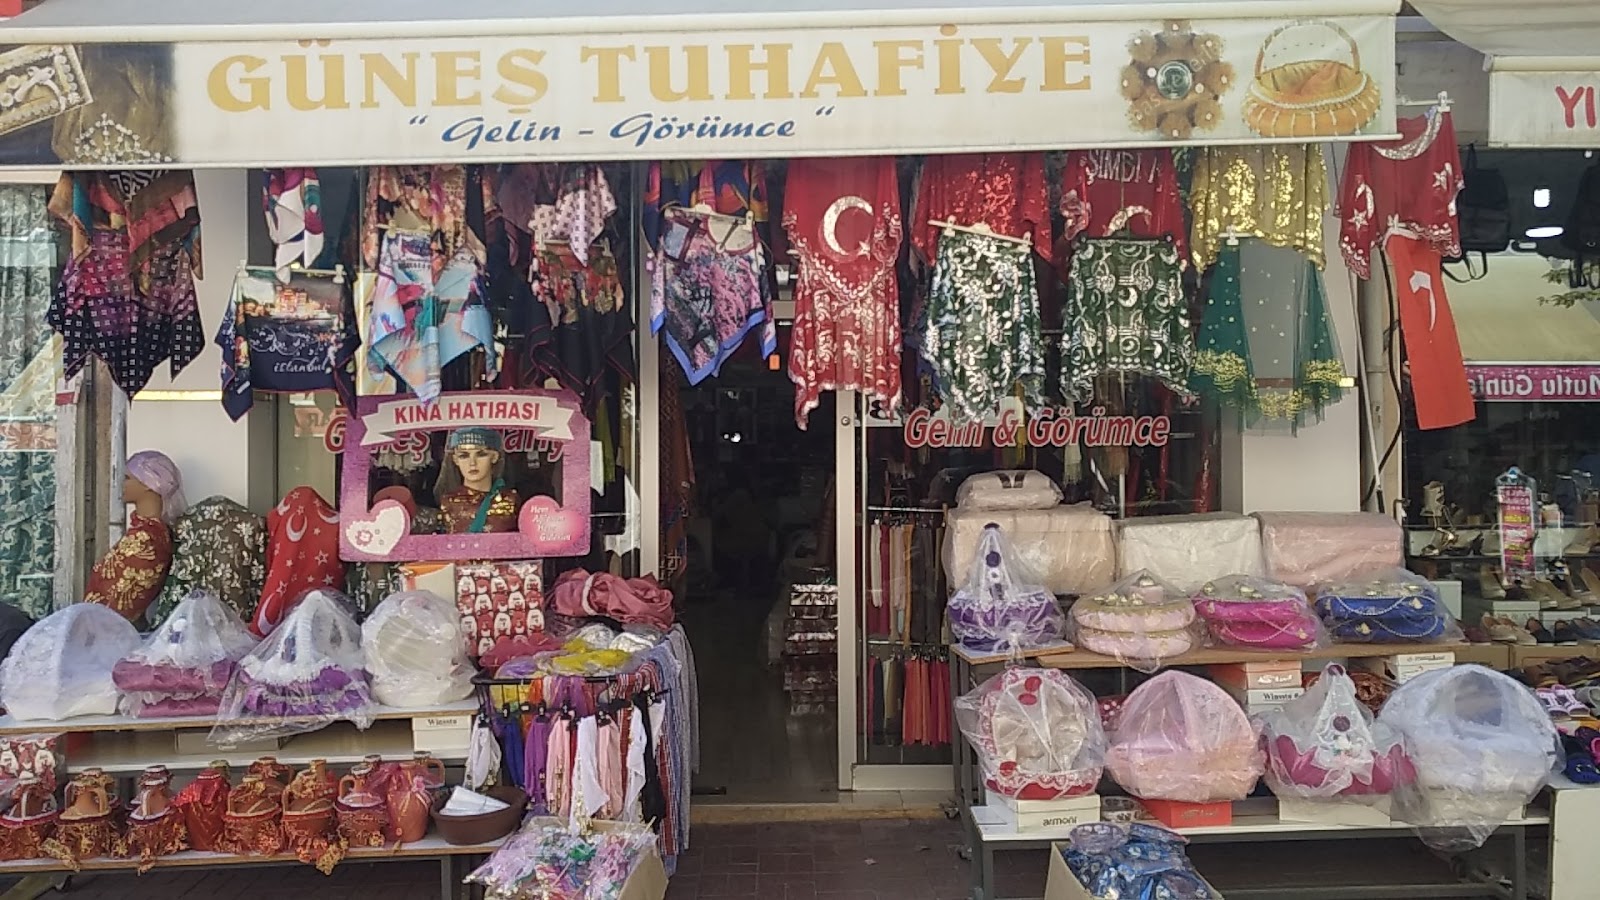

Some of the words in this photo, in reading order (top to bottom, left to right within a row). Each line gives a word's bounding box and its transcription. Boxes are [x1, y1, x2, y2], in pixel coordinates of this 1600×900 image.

[207, 38, 549, 114] GÜNEŞ
[580, 24, 1093, 102] TUHAFİYE
[1554, 86, 1600, 128] YI
[441, 115, 561, 150] Gelin
[609, 113, 796, 148] Görümce
[394, 403, 442, 425] KINA
[448, 401, 540, 421] HATIRASI
[993, 407, 1018, 448] &
[1028, 406, 1170, 448] Görümce
